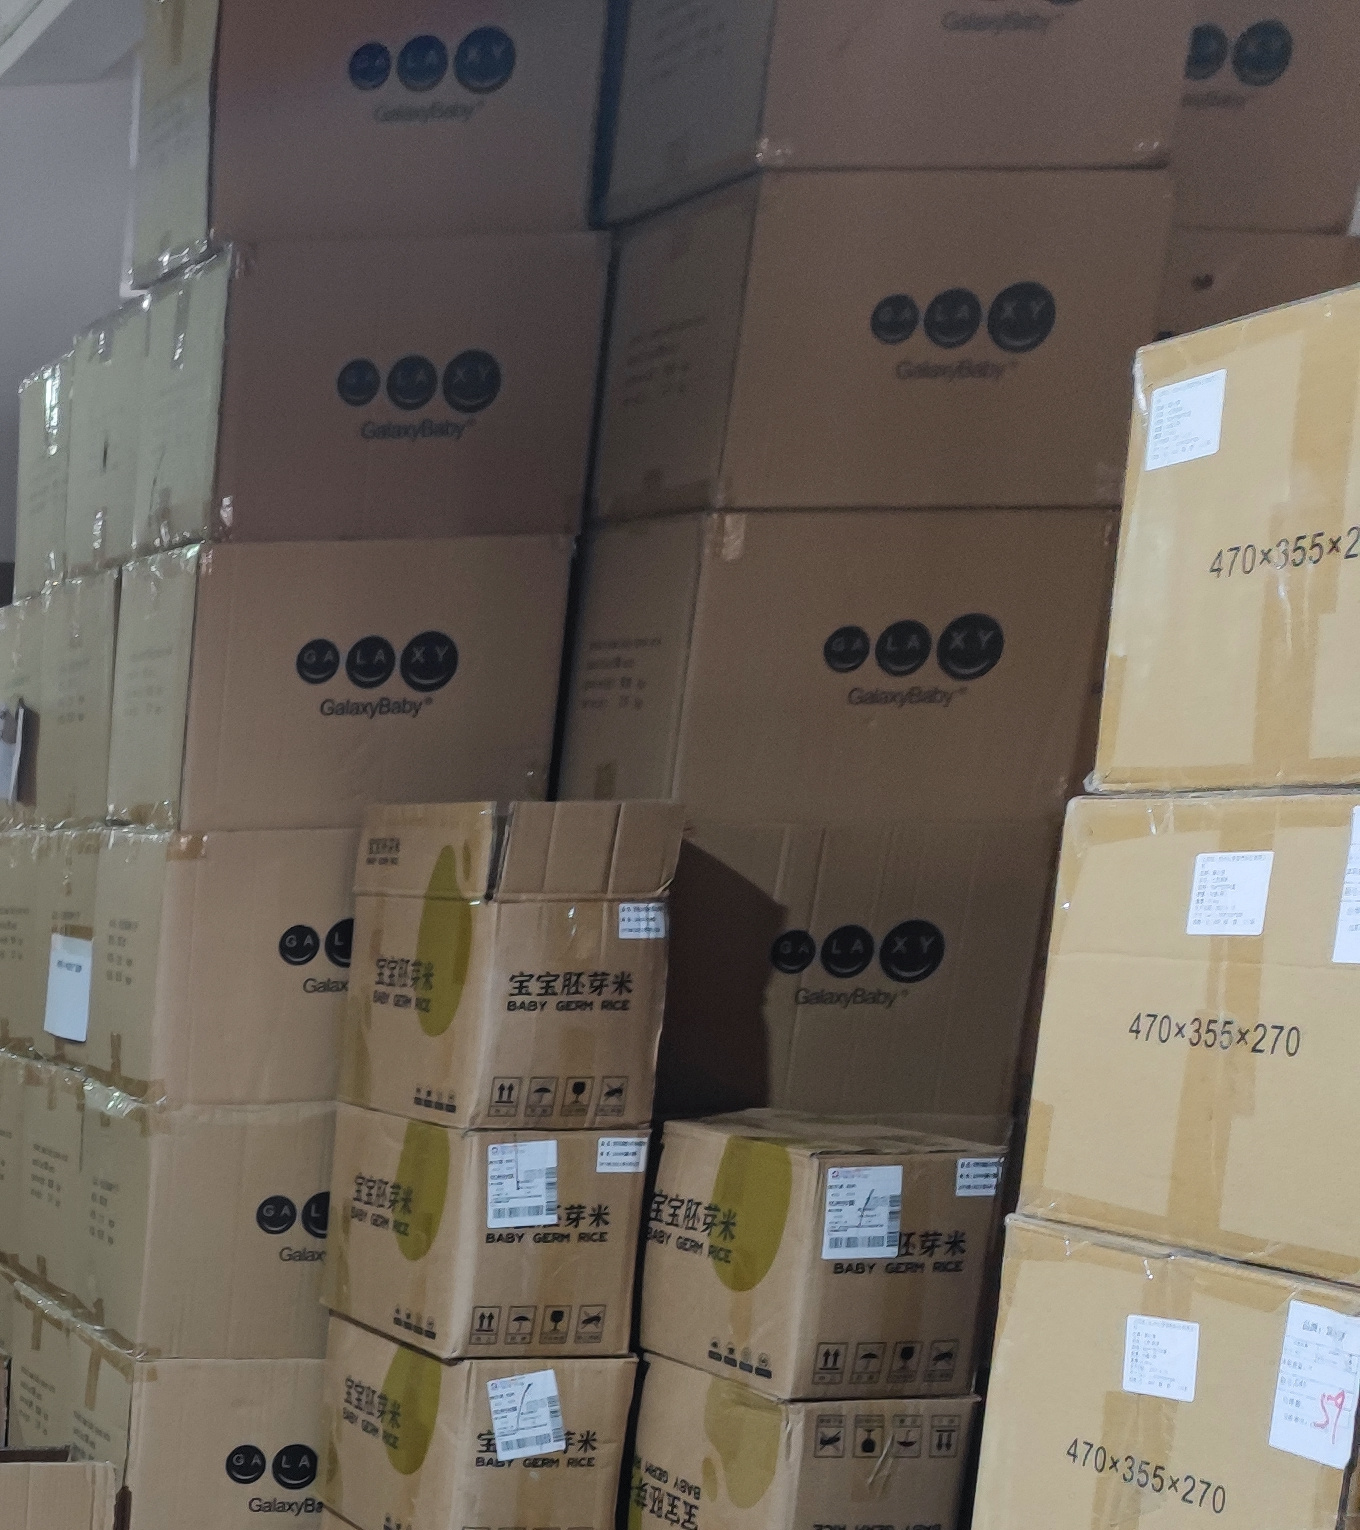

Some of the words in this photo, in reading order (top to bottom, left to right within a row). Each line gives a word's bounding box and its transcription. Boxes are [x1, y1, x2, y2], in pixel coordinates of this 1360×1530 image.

[320, 698, 424, 718] GalaxyBaby
[508, 971, 633, 997] 宝宝胚芽米
[507, 1000, 547, 1012] BABY
[556, 1000, 594, 1012] GERM
[600, 1000, 630, 1012] RICE
[486, 1232, 525, 1244] BABY
[533, 1232, 571, 1244] GERM
[578, 1232, 608, 1244] RICE
[833, 1261, 876, 1274] BABY
[885, 1261, 925, 1274] GERM
[932, 1260, 964, 1273] RICE
[476, 1456, 513, 1469] BABY
[522, 1456, 560, 1469] GERM
[567, 1456, 596, 1468] RICE
